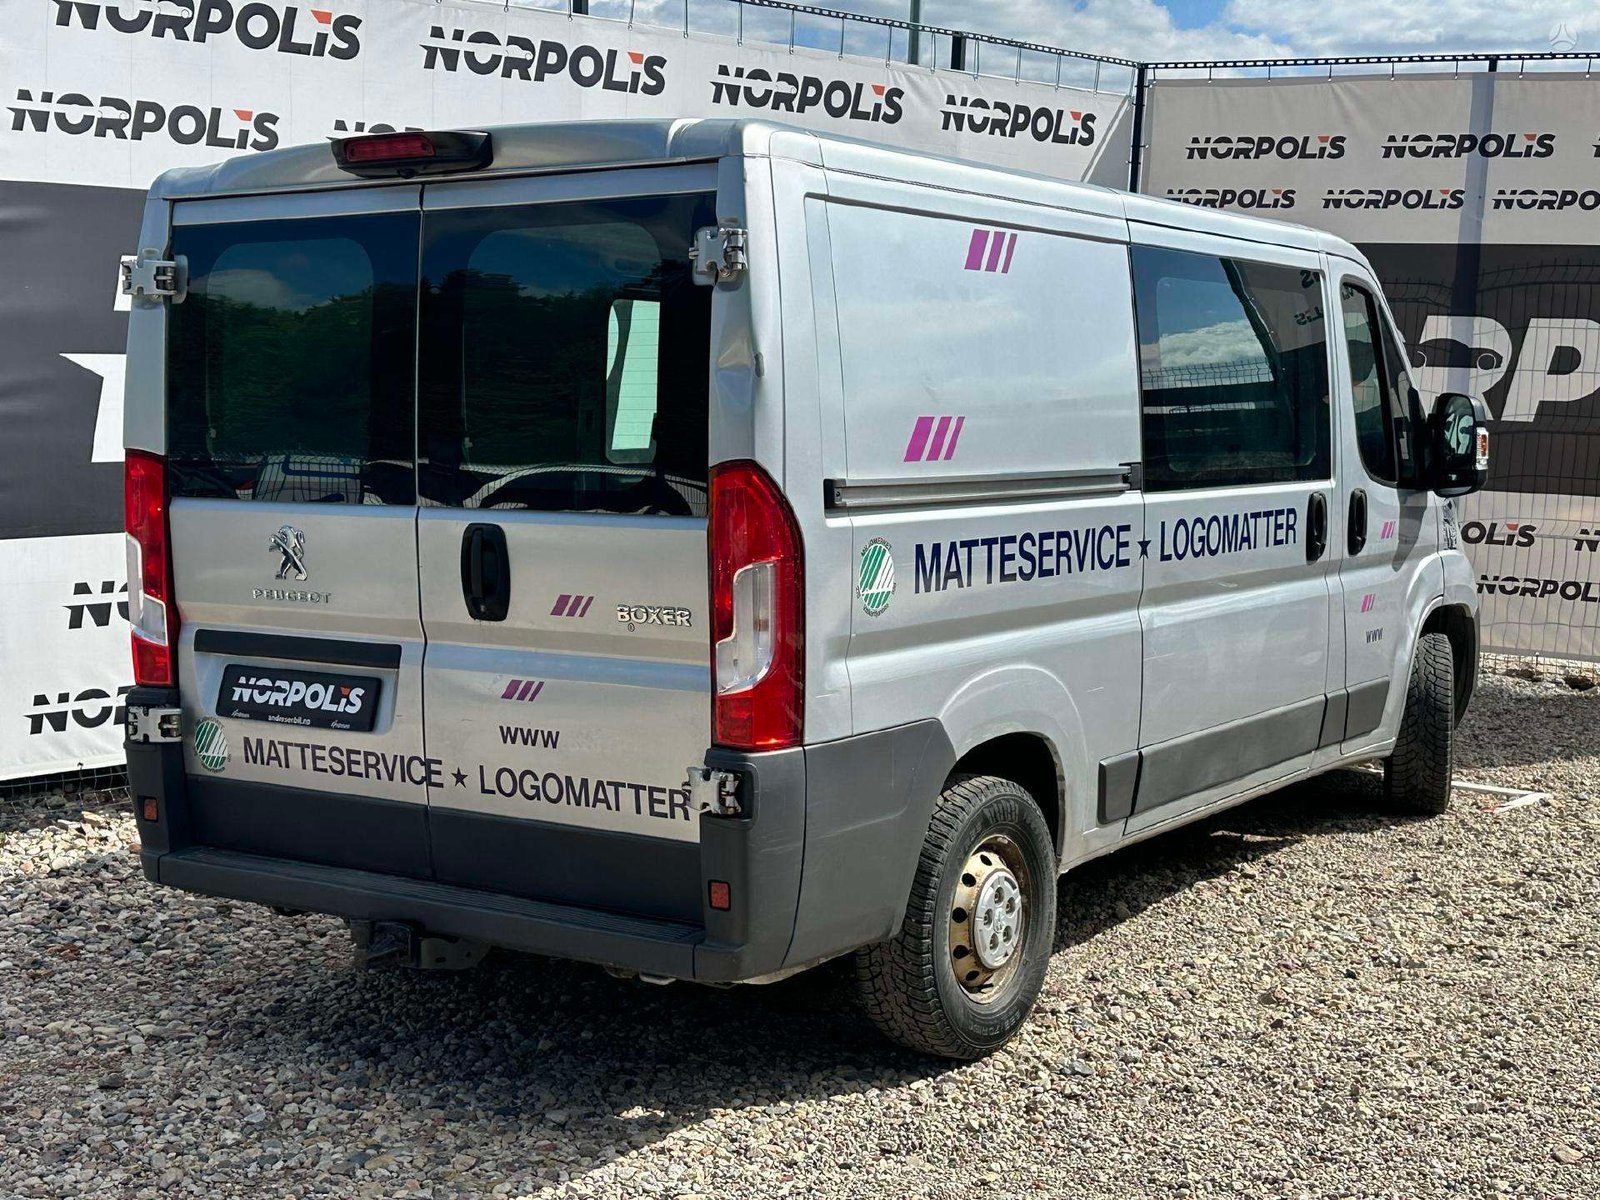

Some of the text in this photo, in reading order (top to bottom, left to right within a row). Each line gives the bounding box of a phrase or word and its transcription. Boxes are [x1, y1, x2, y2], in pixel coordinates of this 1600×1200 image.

[914, 507, 1298, 595] MATTESERVICE LOGOMATTER
[252, 587, 332, 604] PEUGEOT
[616, 604, 692, 627] BOXER
[243, 736, 691, 822] MATTESERVICE LOGOMATTER
